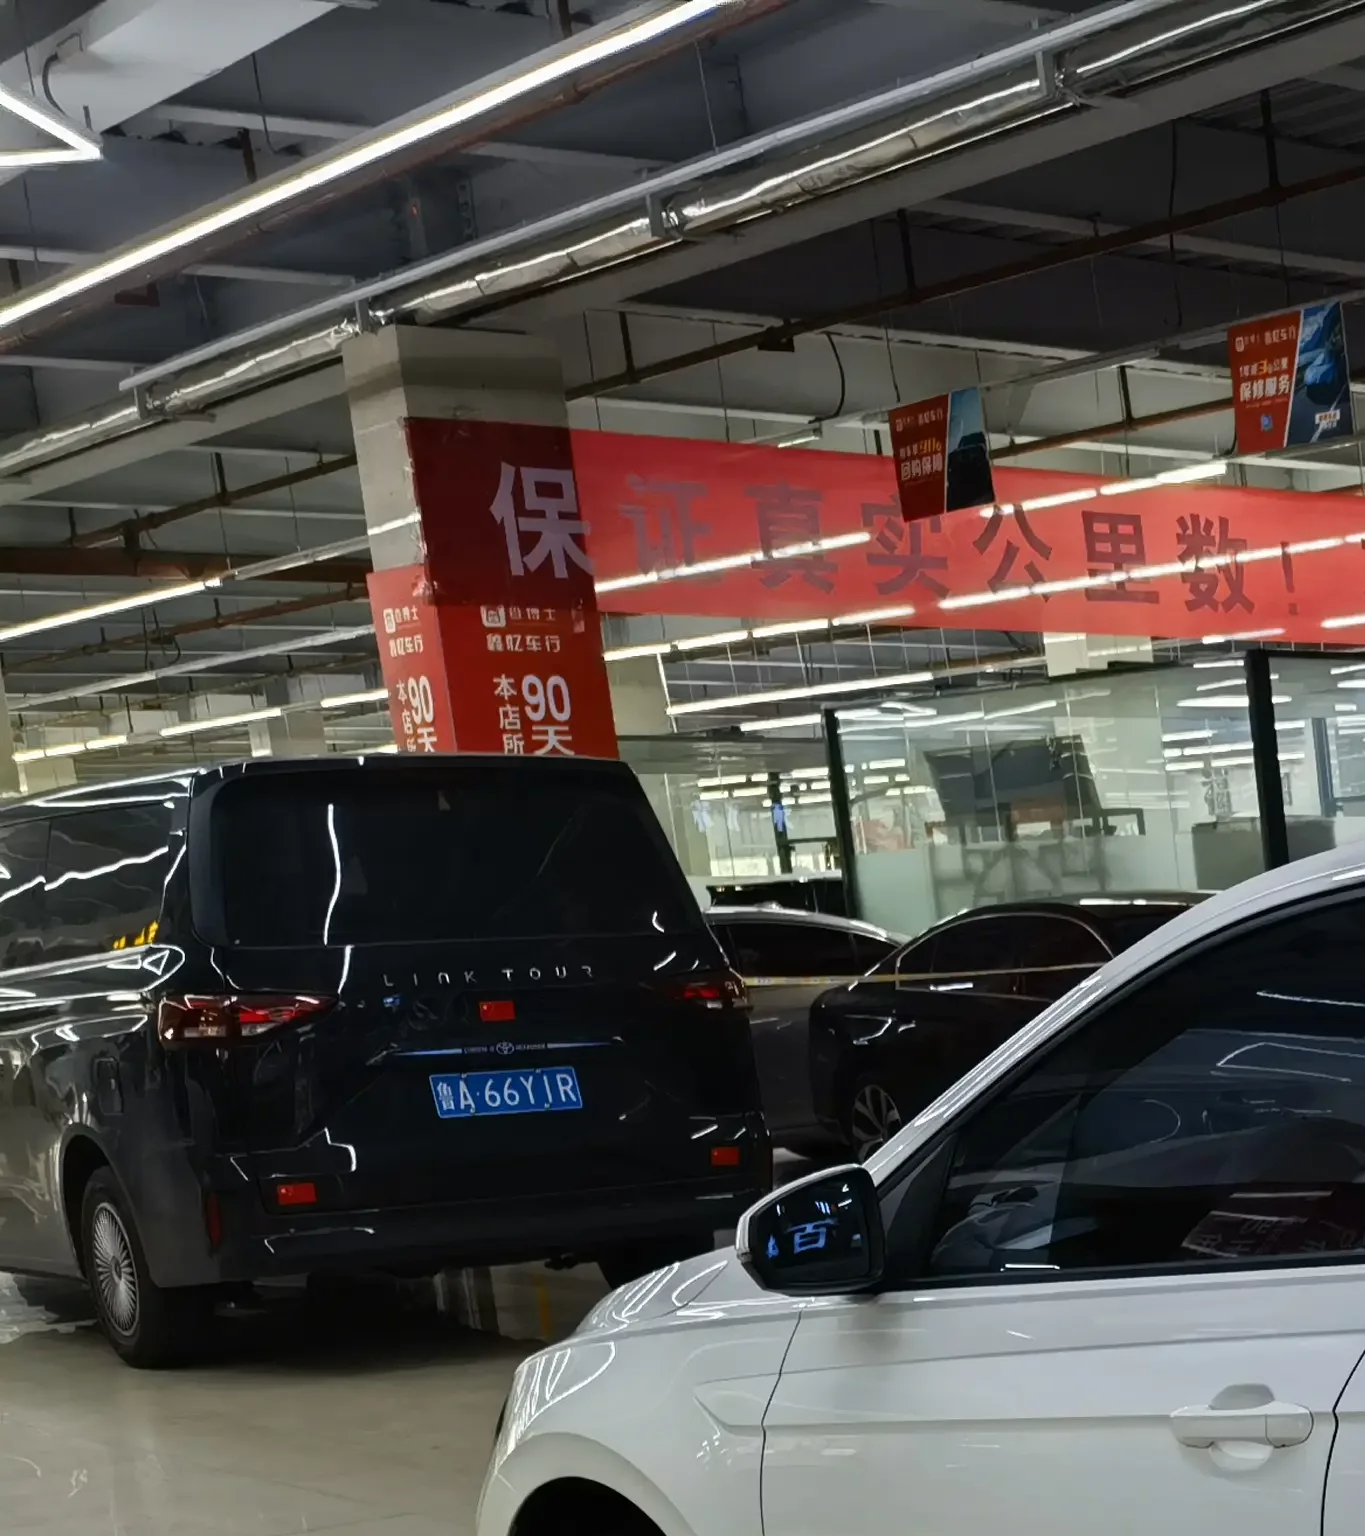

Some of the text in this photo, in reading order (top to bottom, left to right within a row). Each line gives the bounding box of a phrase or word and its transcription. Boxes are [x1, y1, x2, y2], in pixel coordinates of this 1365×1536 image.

[408, 675, 437, 753] 90天
[493, 674, 524, 754] 本店所
[521, 674, 575, 755] 90天
